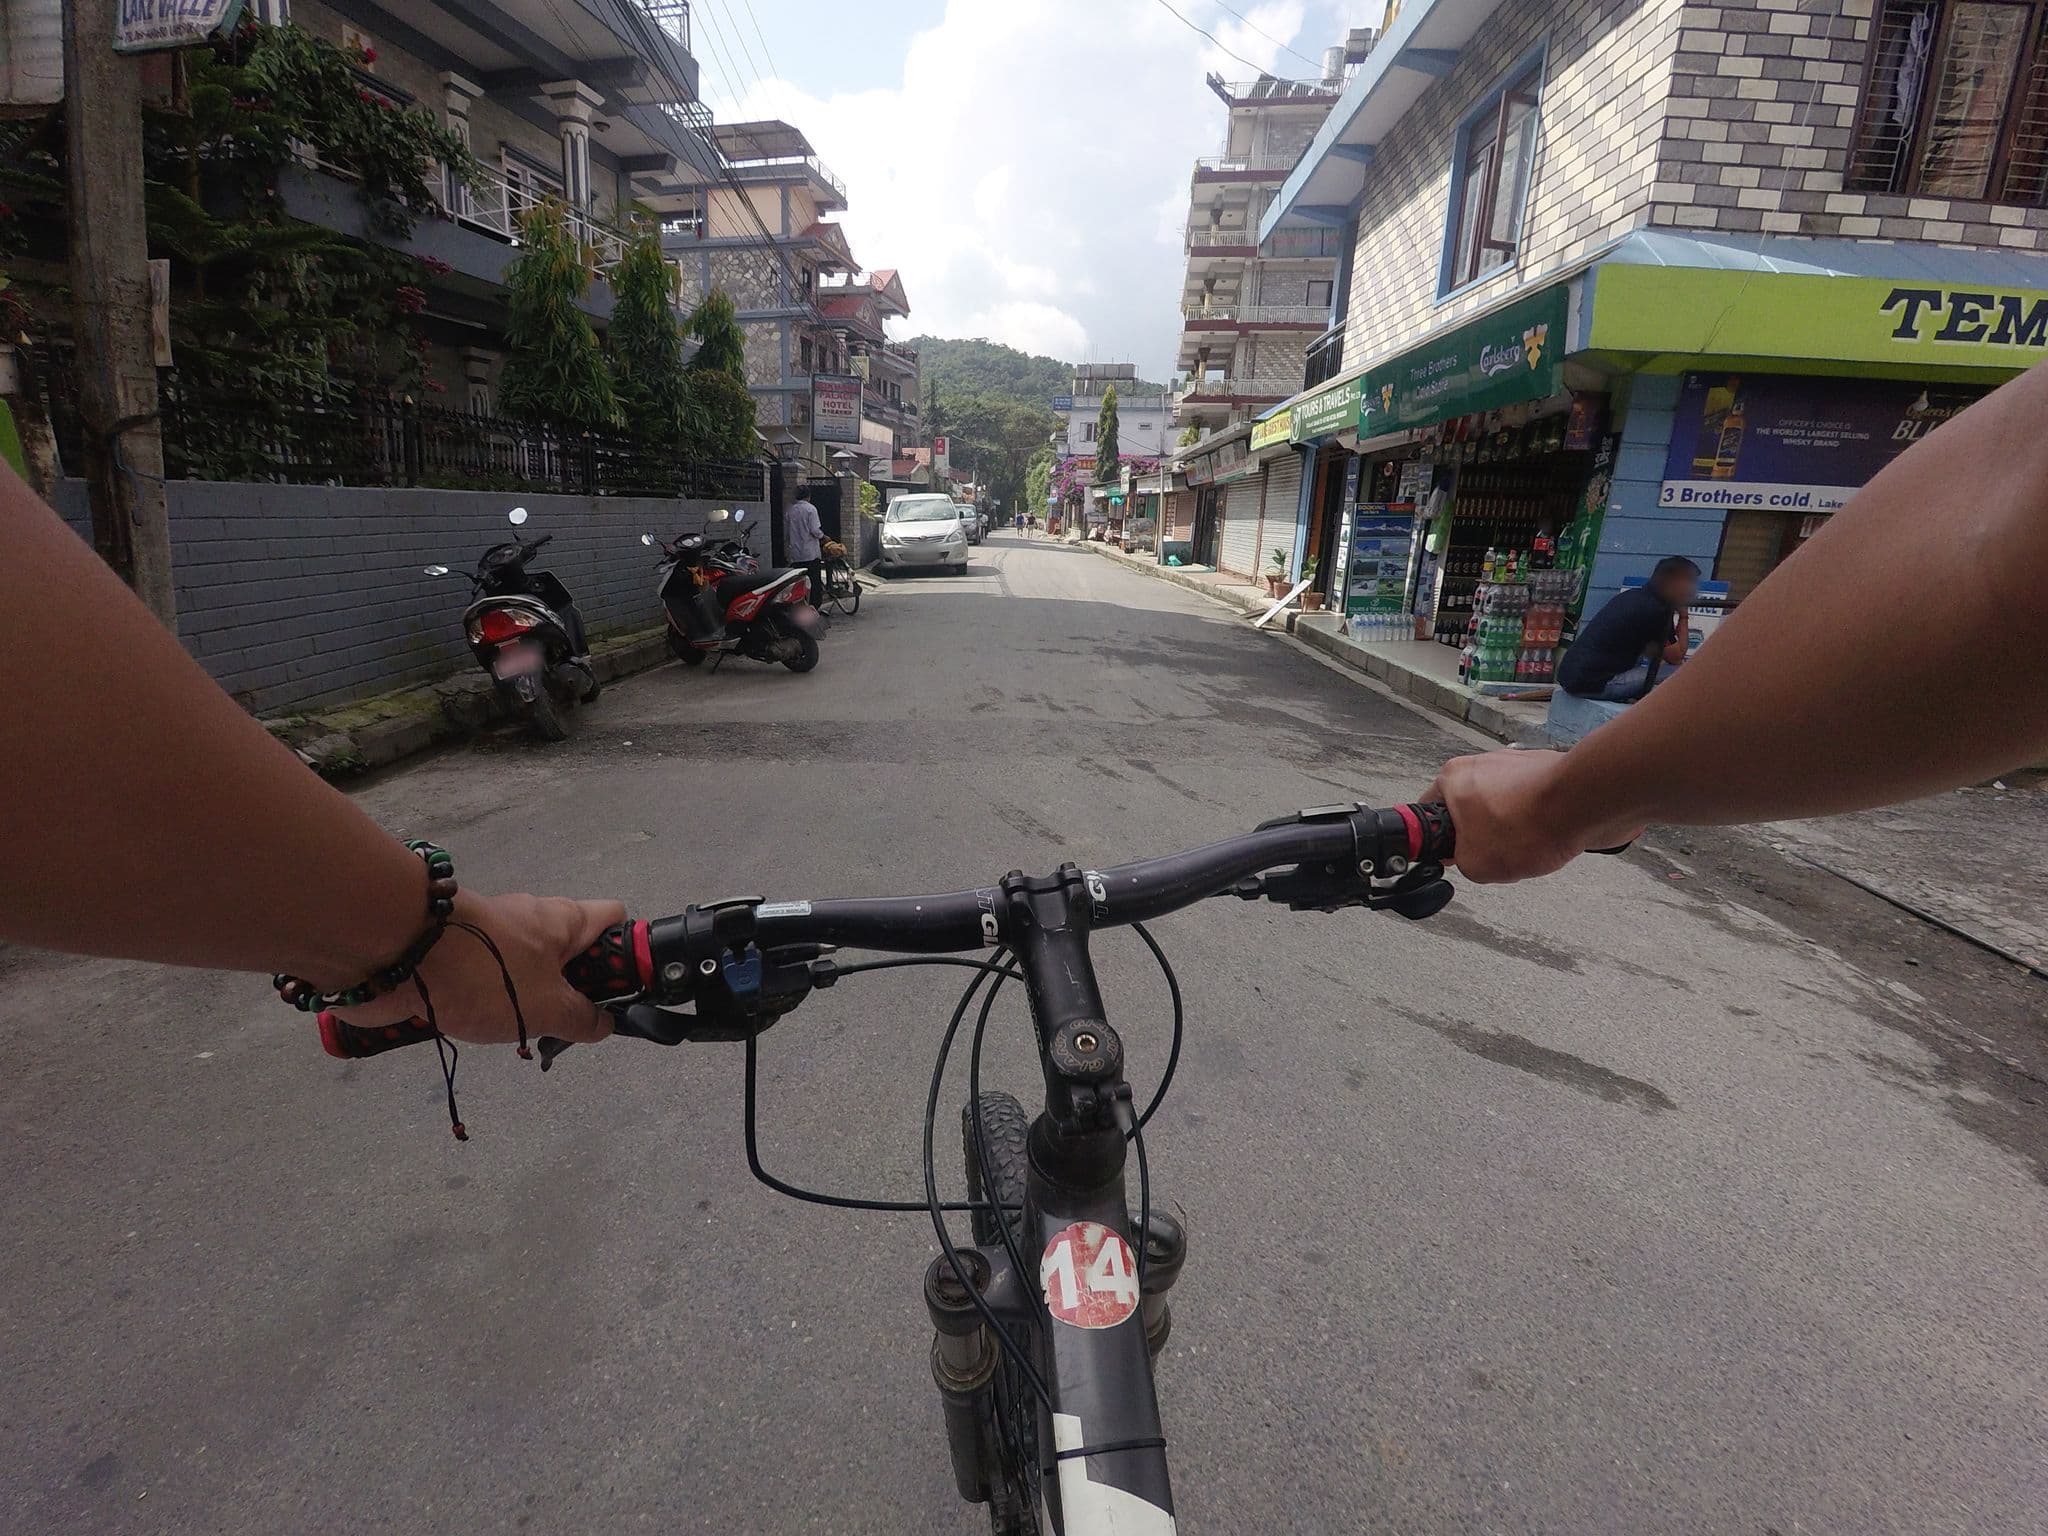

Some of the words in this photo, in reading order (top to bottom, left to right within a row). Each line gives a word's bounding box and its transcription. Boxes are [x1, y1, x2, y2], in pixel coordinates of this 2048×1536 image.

[1428, 355, 1458, 377] Brothers
[1480, 344, 1520, 377] Carlsberg
[823, 401, 854, 409] HOTEL
[1302, 400, 1319, 419] TOURS
[1323, 387, 1350, 412] TRAVELS
[1772, 428, 1806, 437] WORLD'S
[1807, 430, 1839, 438] LARGEST
[1840, 431, 1870, 440] SELLING
[1782, 438, 1811, 446] WHISKY
[1813, 439, 1840, 447] BRAND
[1662, 487, 1674, 502] 3
[1681, 487, 1763, 505] Brothers
[1043, 1236, 1133, 1310] 14
